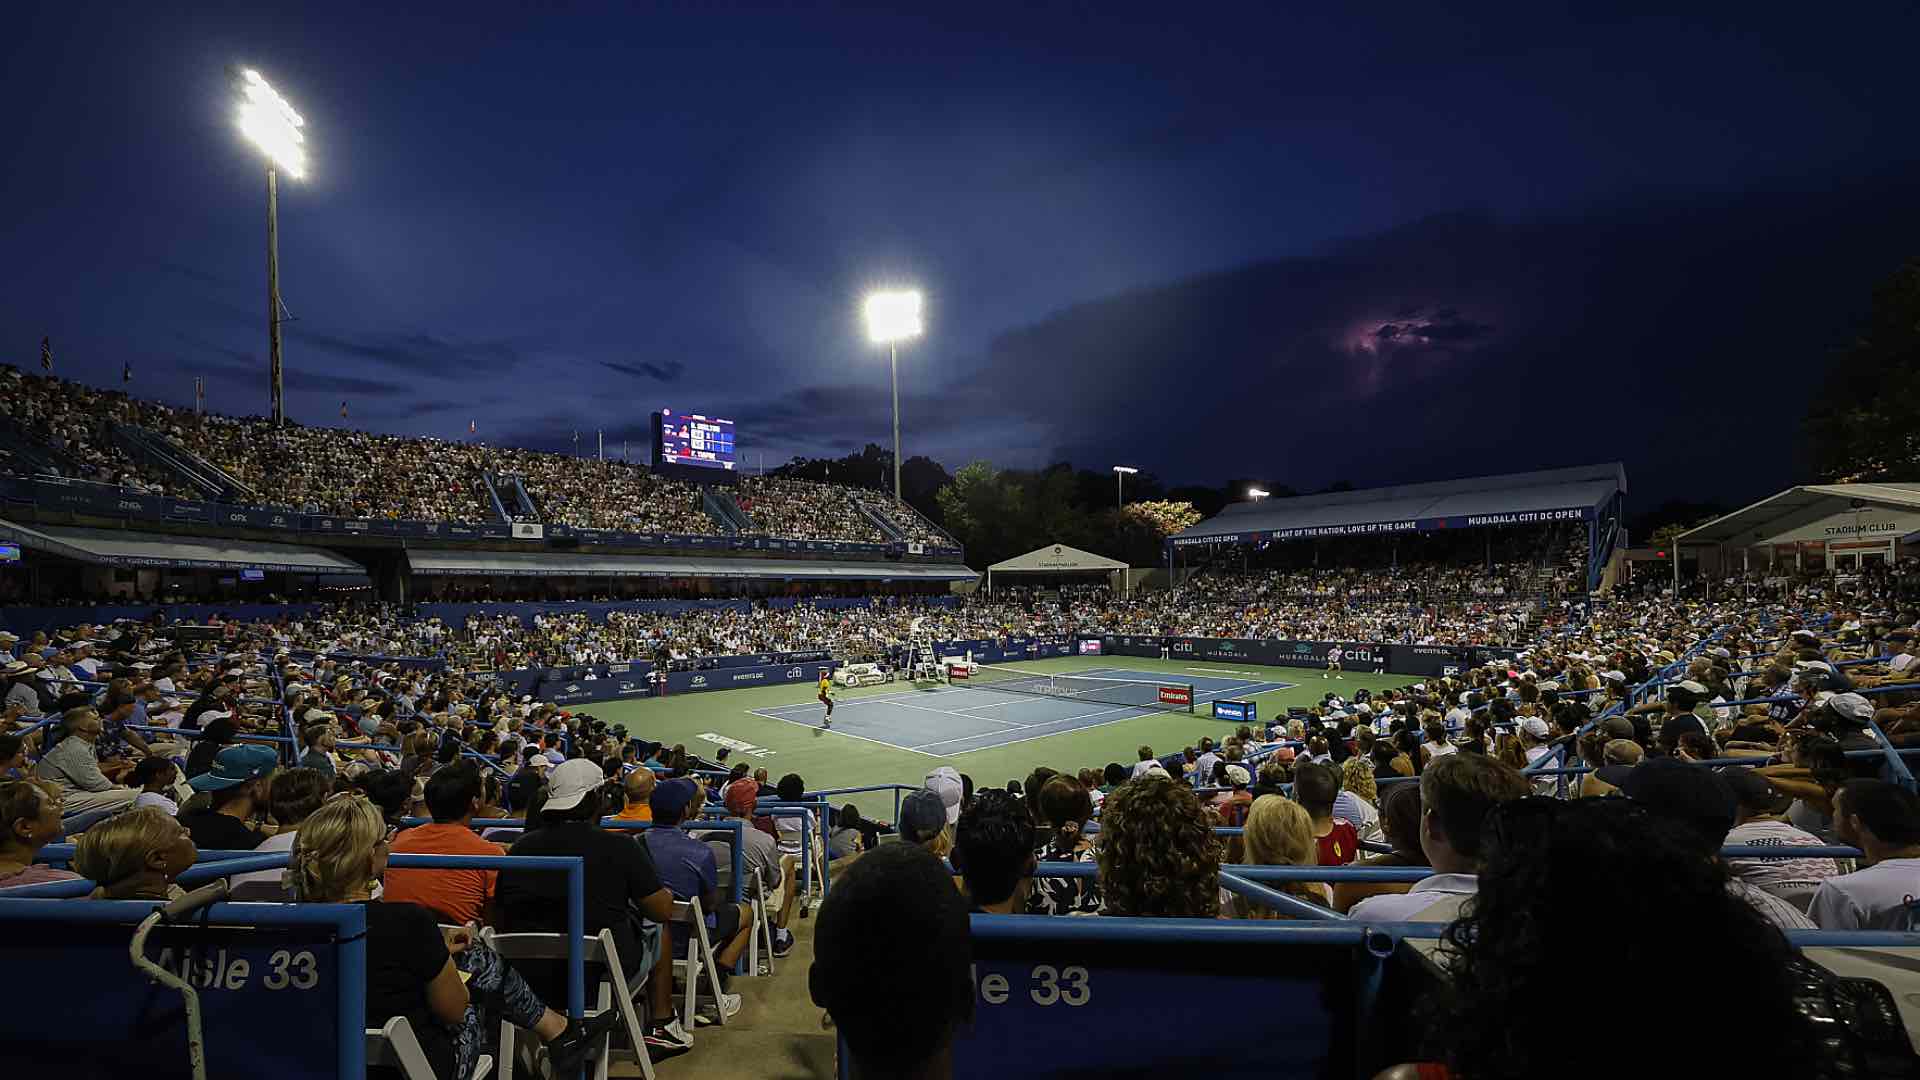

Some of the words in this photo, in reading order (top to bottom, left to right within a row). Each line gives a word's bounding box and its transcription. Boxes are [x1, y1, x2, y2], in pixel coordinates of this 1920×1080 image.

[1468, 514, 1517, 526] MUBADALA
[1519, 512, 1538, 521] CITI
[1540, 511, 1553, 520] DC
[1555, 509, 1582, 519] OPEN
[1294, 529, 1303, 537] OF
[1304, 528, 1317, 537] THE
[1318, 527, 1347, 536] NATION,
[1347, 525, 1366, 534] LOVE
[1367, 524, 1378, 532] OF
[1379, 523, 1393, 531] THE
[1394, 521, 1416, 529] GAME
[1824, 525, 1867, 535] STADIUM
[1869, 523, 1896, 532] CLUB
[1173, 640, 1193, 652] citi
[1207, 650, 1248, 658] MUBADALA
[1279, 653, 1327, 663] MUBADALA
[786, 667, 802, 679] citi
[264, 949, 319, 990] 33
[1030, 964, 1090, 1007] 33
